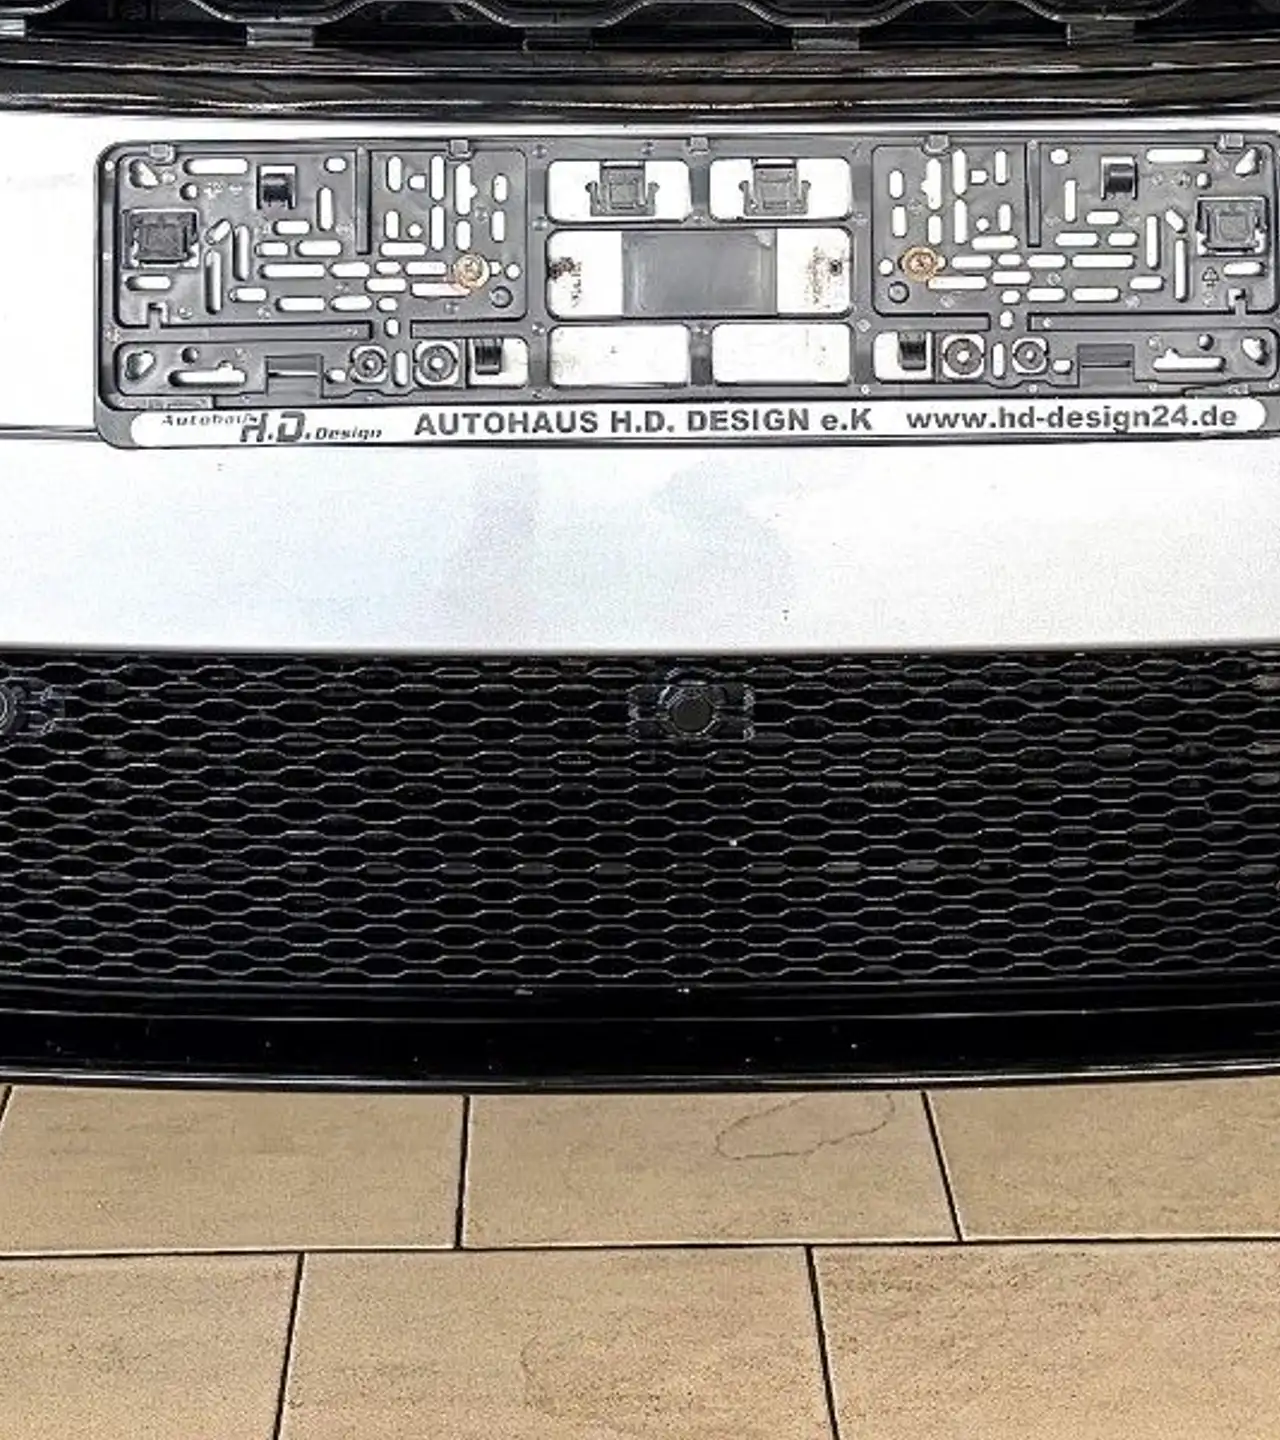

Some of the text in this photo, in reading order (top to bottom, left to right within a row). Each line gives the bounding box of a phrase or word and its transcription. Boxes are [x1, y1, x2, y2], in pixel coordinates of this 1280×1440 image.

[414, 404, 1238, 436] AUTOHAUS H.D. DESIGN e.K www.hd-design24.de
